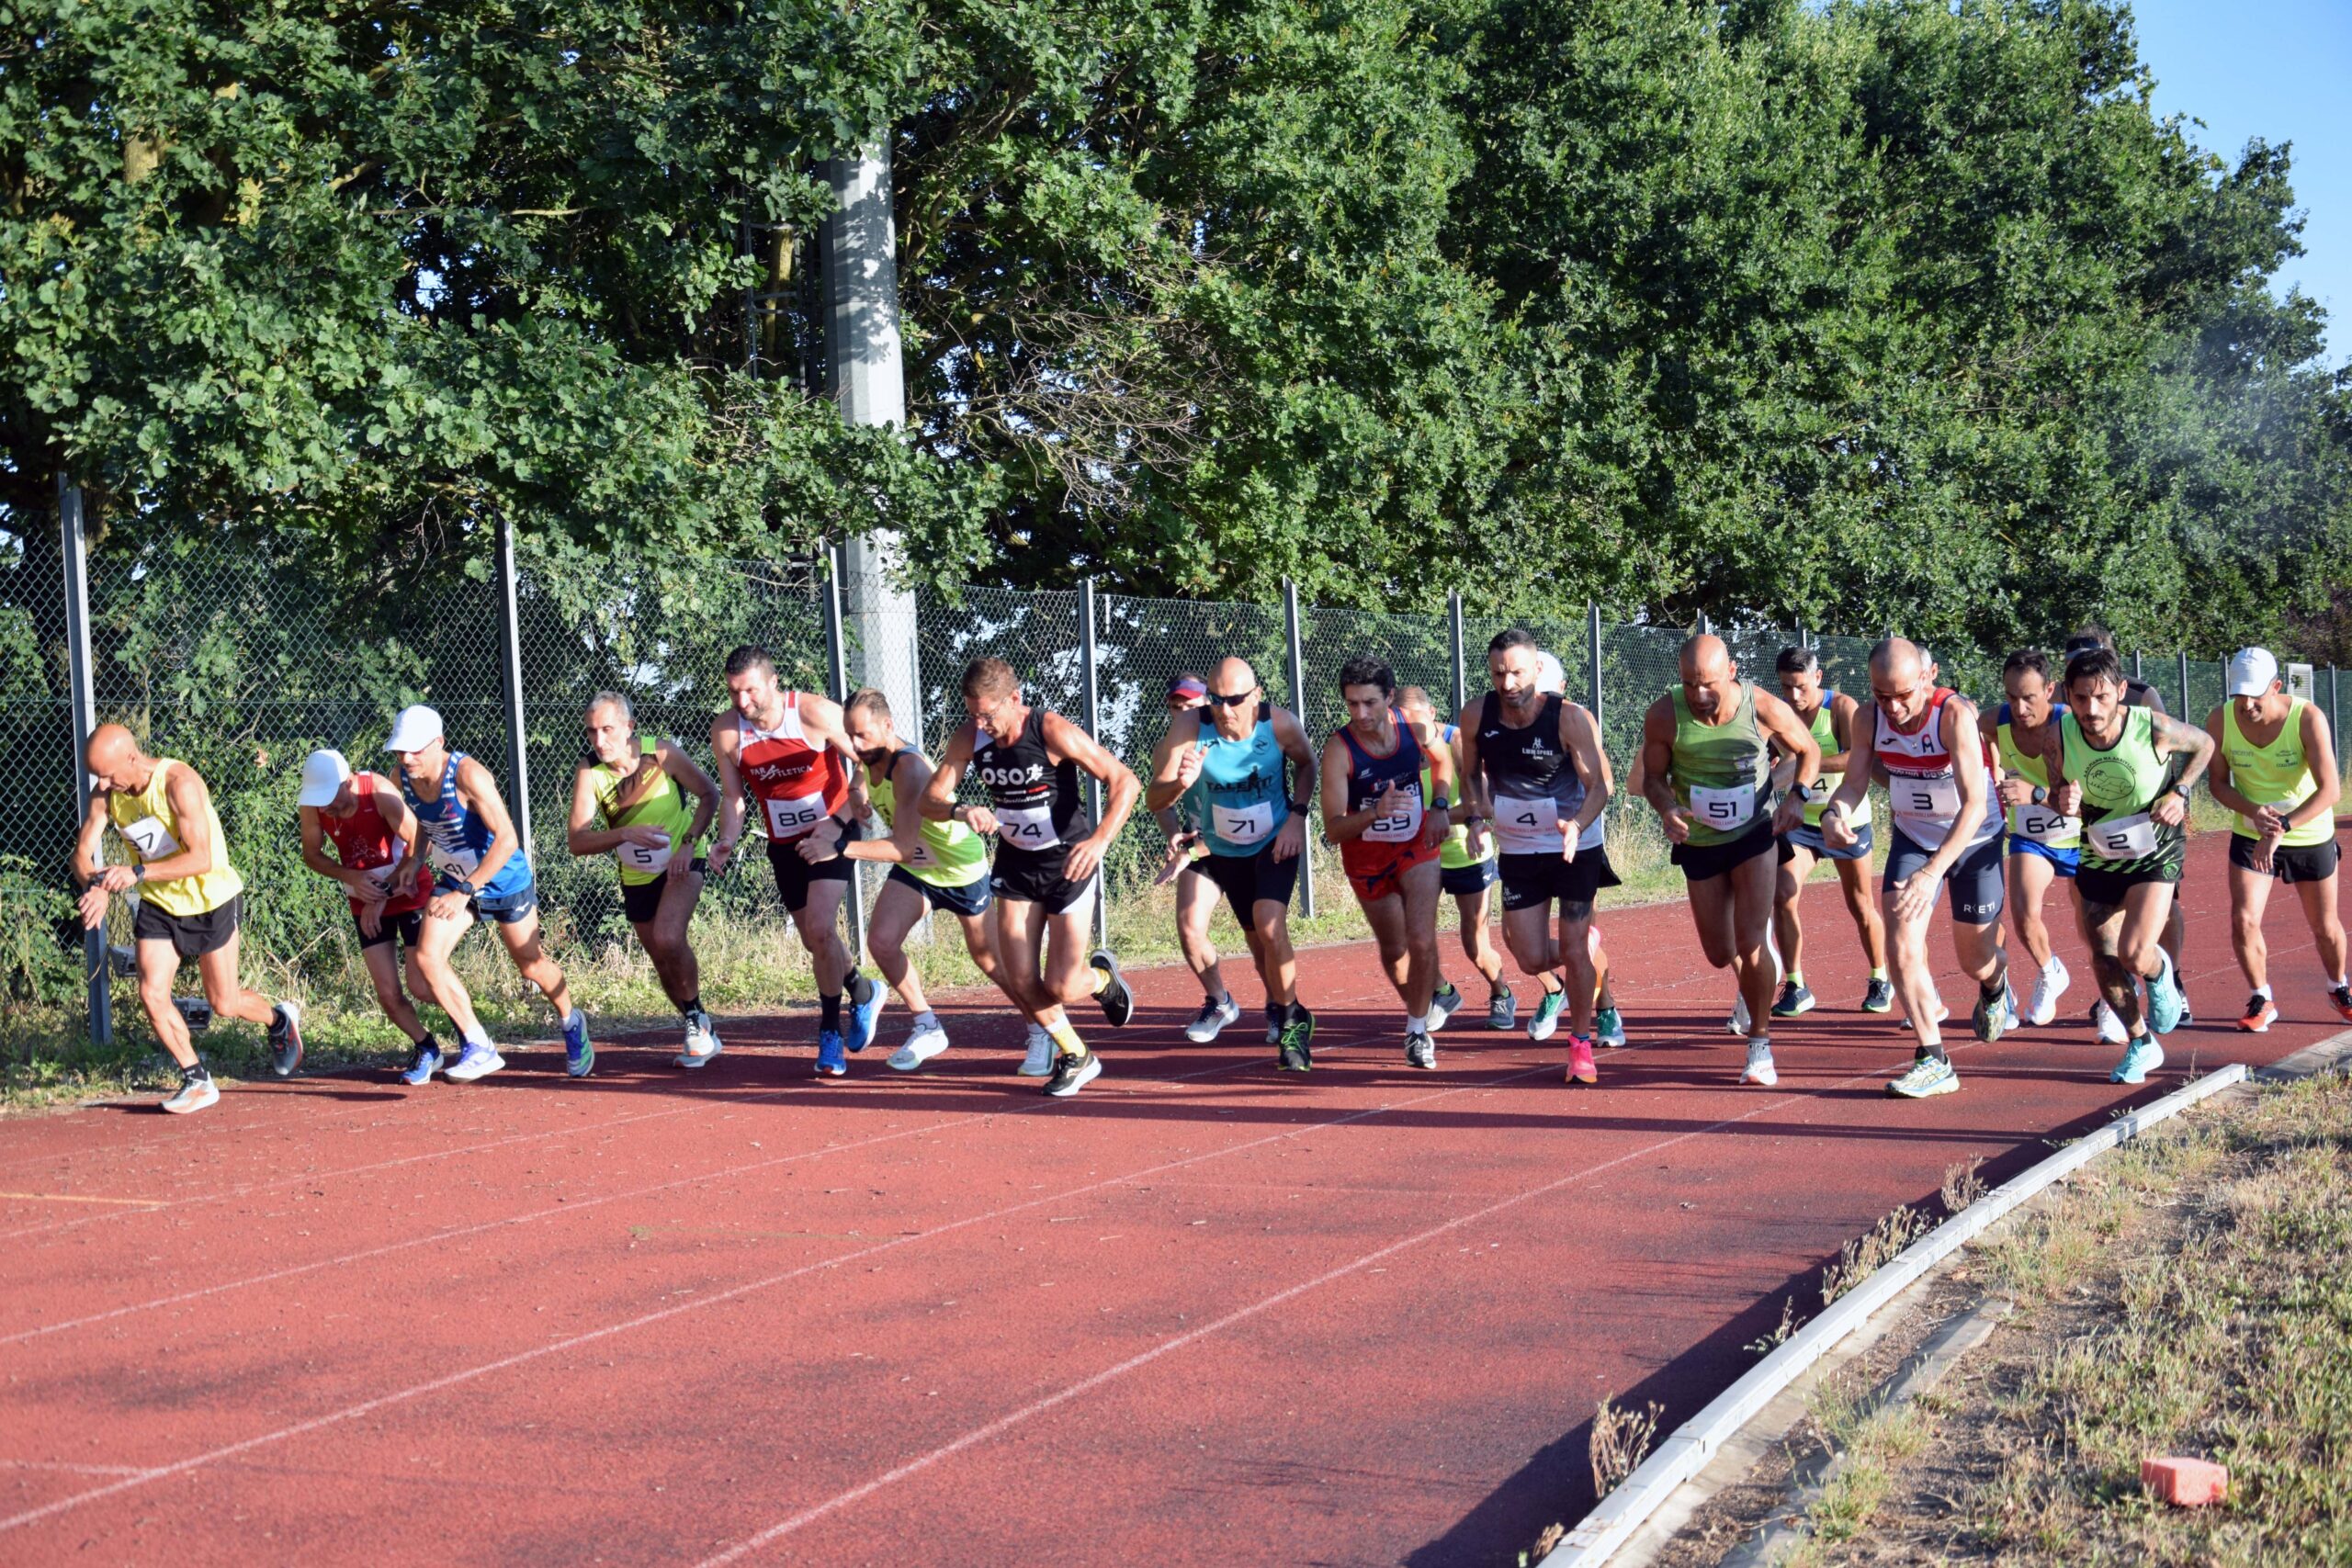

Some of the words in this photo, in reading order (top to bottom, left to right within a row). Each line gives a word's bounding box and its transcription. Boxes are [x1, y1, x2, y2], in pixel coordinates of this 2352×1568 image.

[981, 767, 1025, 786] OSO
[1912, 793, 1933, 809] 3
[778, 808, 817, 827] 86
[1709, 801, 1737, 818] 51
[1227, 819, 1255, 833] 71
[1372, 813, 1410, 831] 69
[1516, 812, 1538, 826] 4
[2026, 815, 2067, 833] 64
[1003, 823, 1042, 838] 74
[2107, 833, 2130, 850] 2
[634, 848, 652, 863] 5
[445, 863, 467, 877] 41
